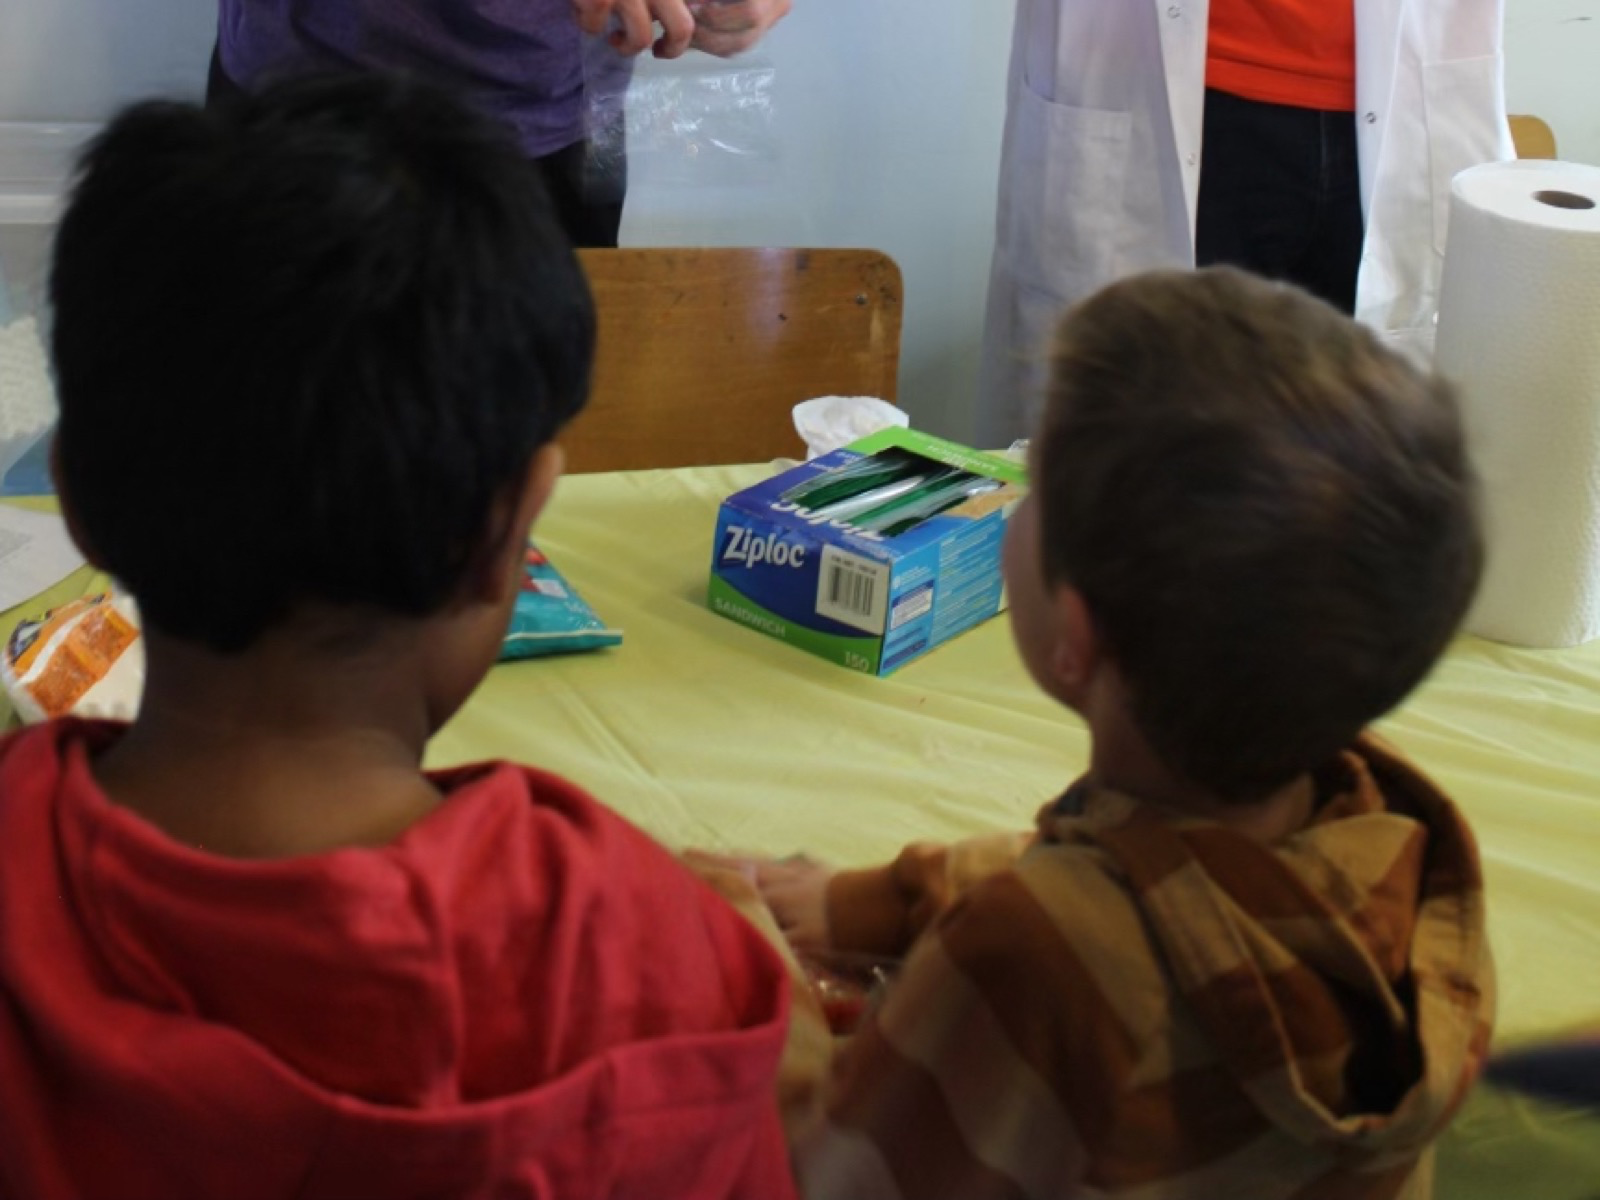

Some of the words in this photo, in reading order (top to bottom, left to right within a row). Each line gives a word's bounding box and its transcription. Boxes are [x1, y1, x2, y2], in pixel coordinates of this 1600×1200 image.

[723, 526, 805, 568] Ziploc
[714, 598, 786, 637] SANDWICH
[845, 651, 869, 673] 150
